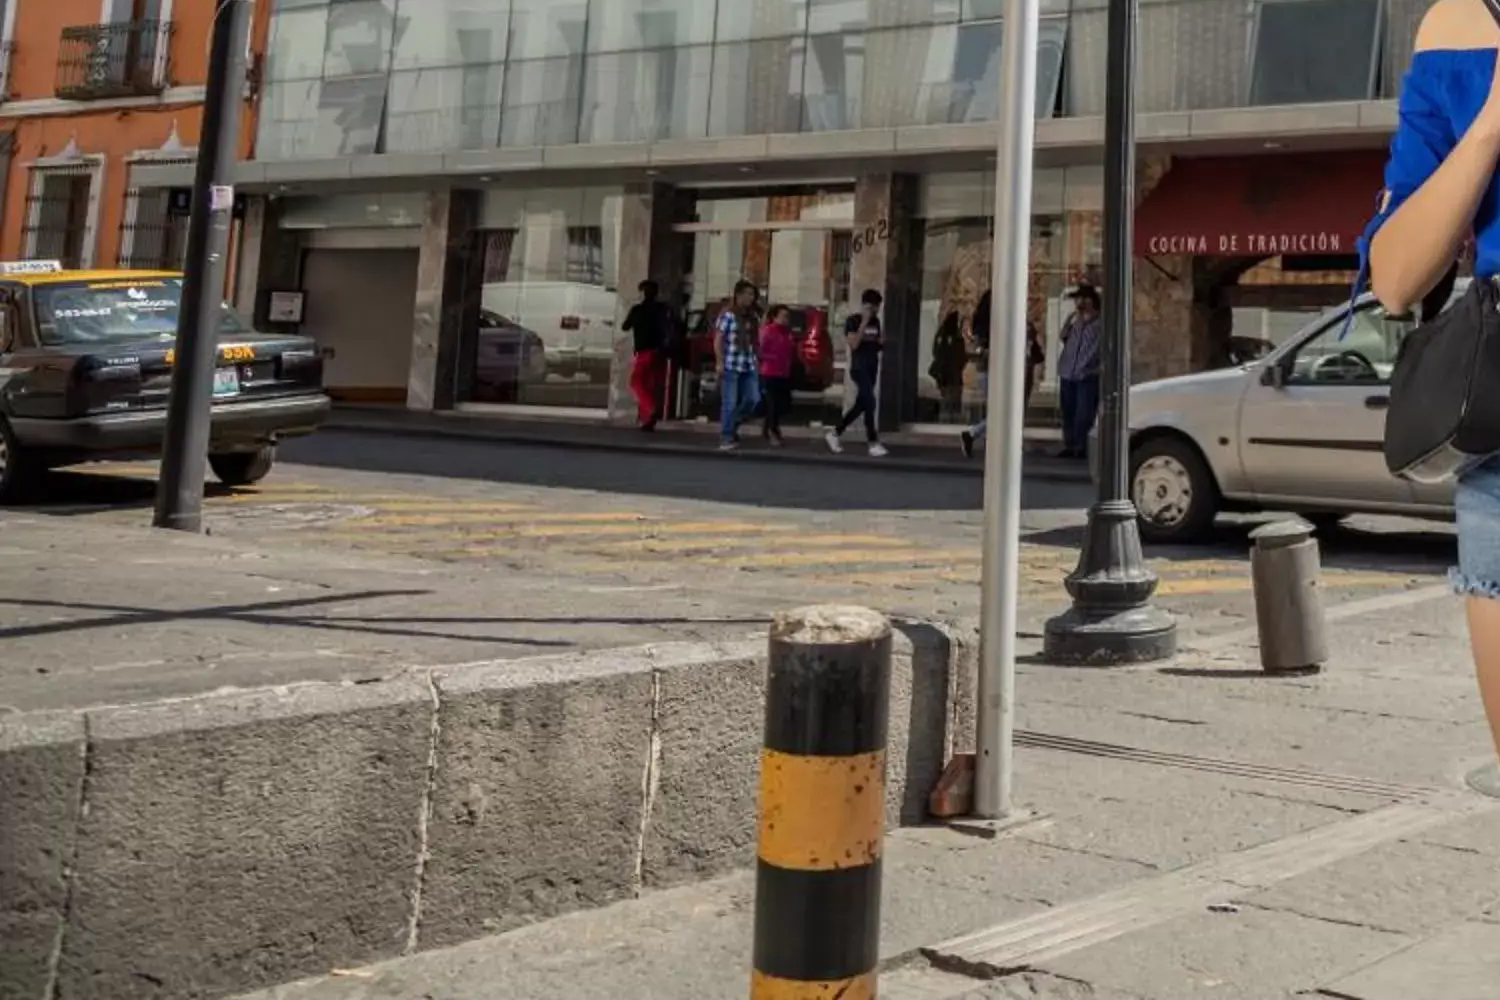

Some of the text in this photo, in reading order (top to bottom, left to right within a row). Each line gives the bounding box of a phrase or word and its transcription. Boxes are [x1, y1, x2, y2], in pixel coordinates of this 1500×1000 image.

[853, 219, 888, 253] 602
[1150, 231, 1340, 253] COCINA DE TRADICIÓN
